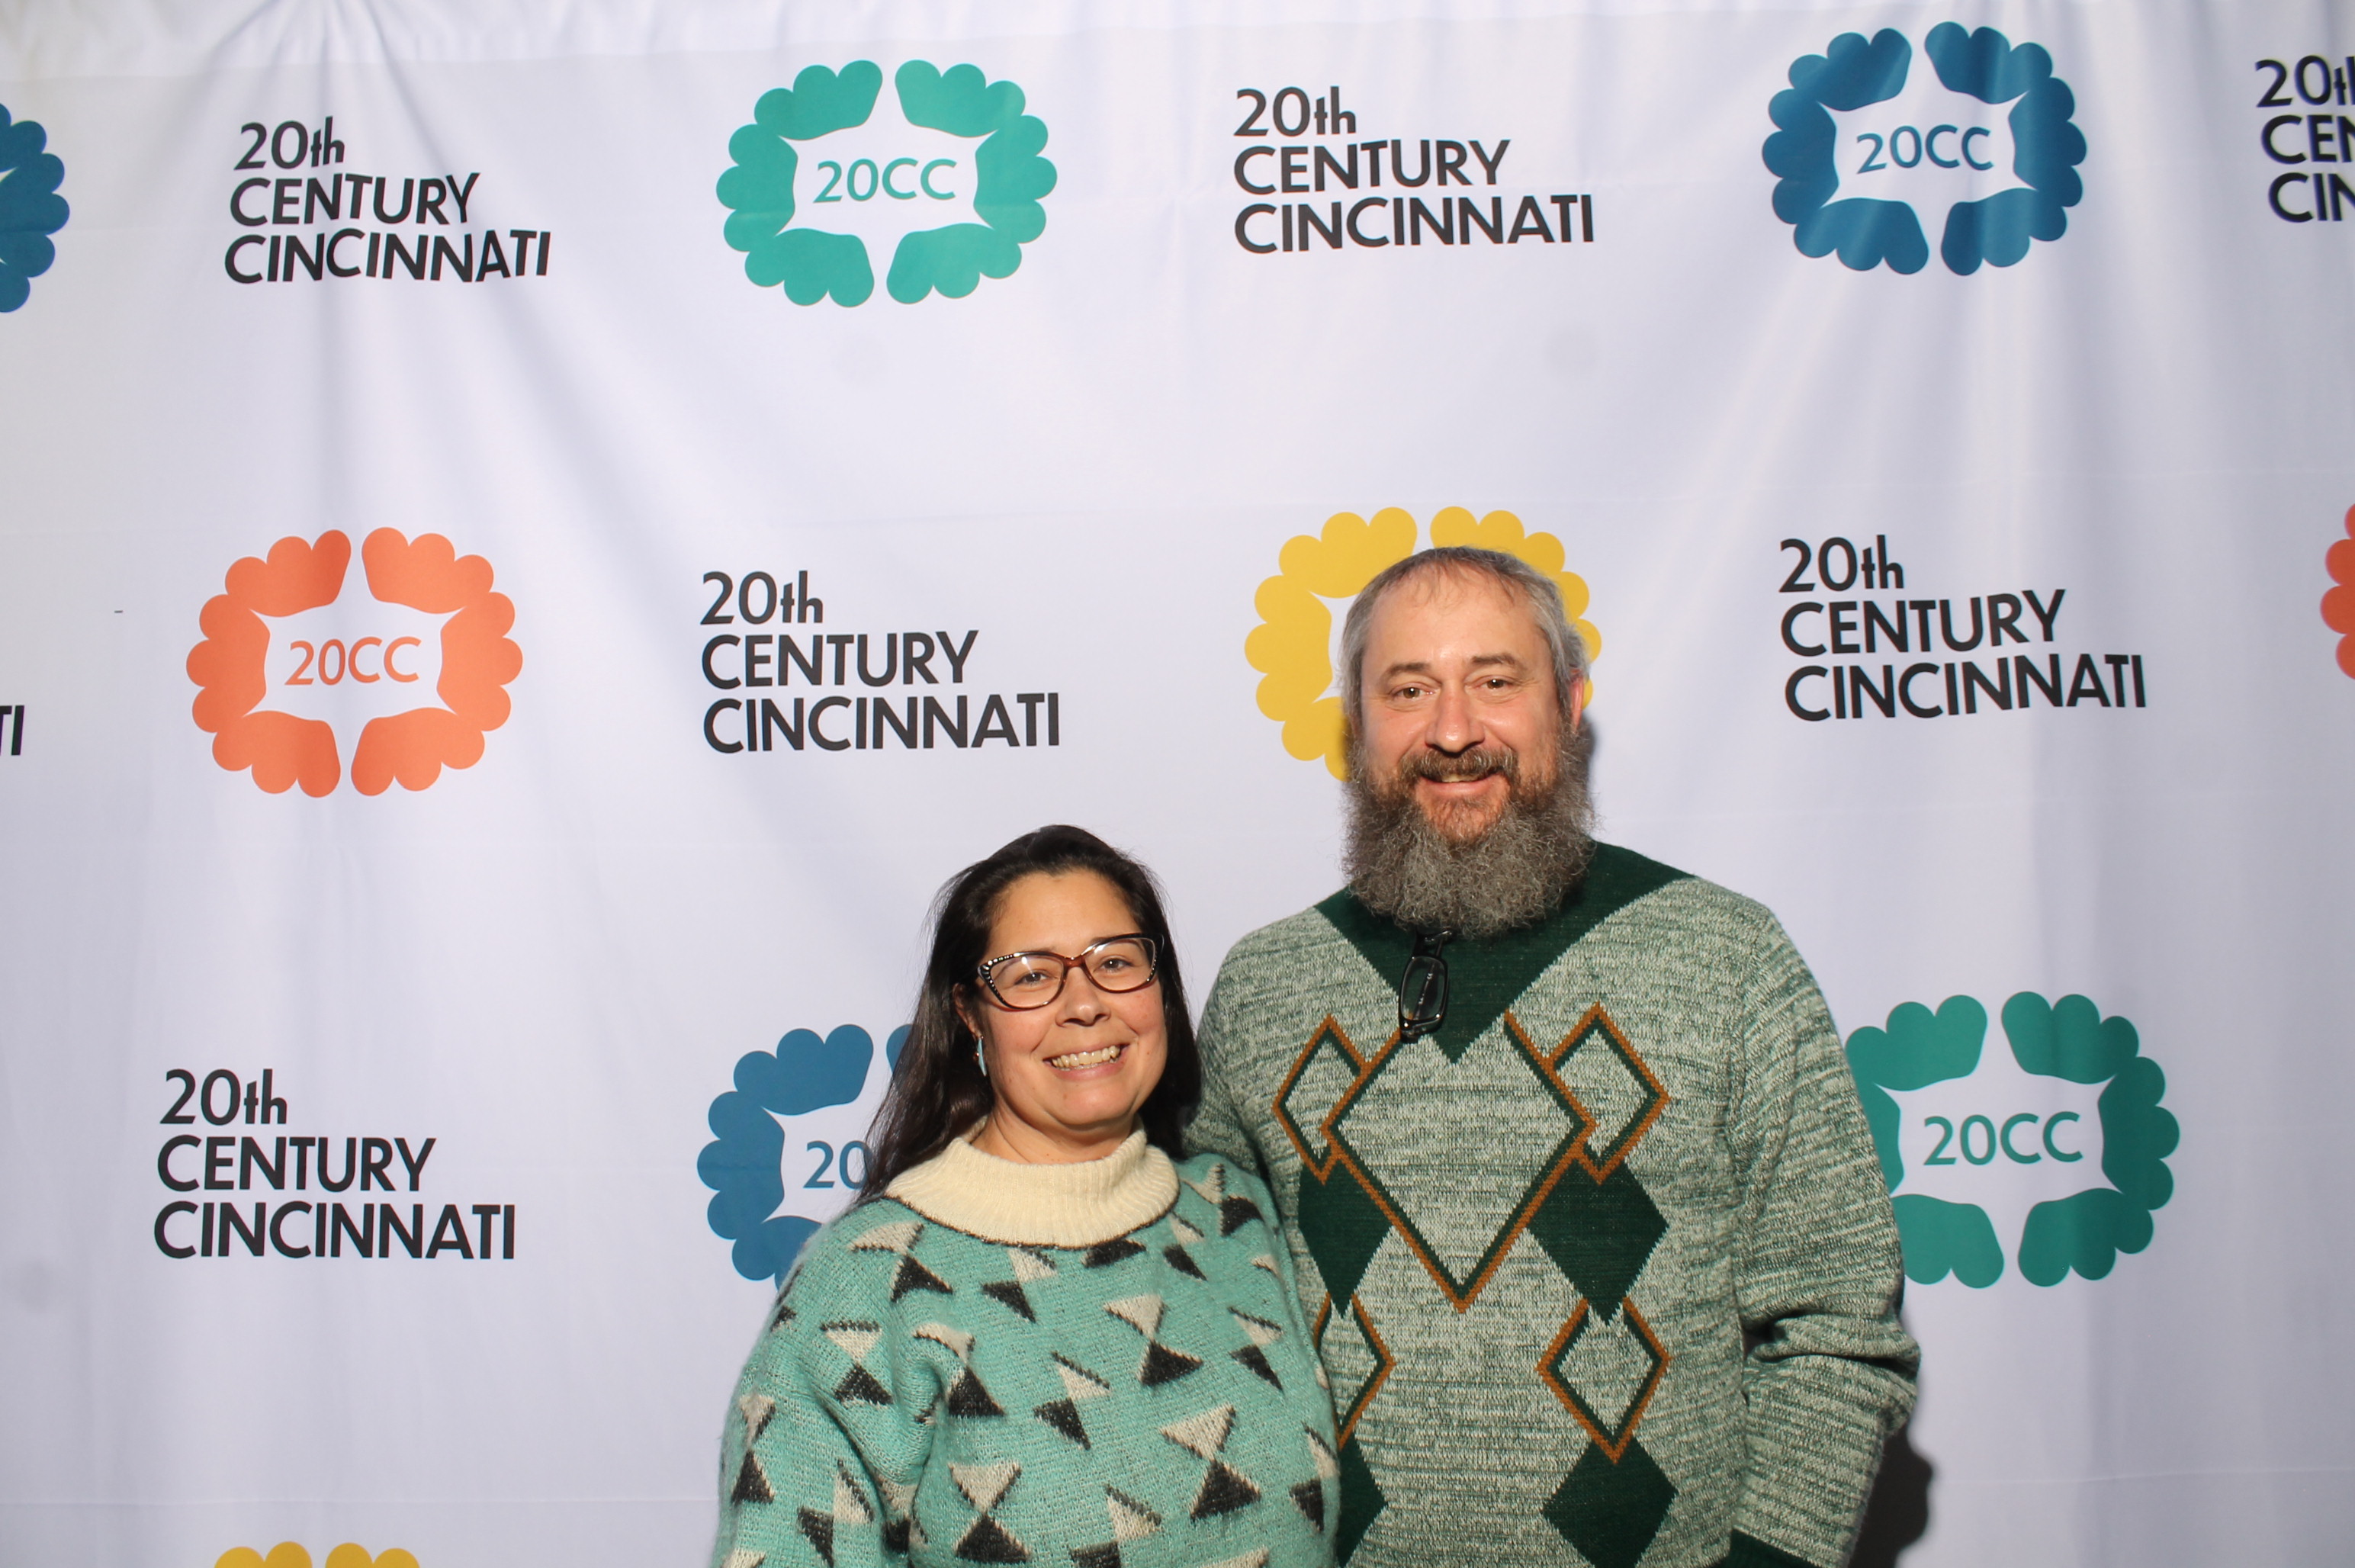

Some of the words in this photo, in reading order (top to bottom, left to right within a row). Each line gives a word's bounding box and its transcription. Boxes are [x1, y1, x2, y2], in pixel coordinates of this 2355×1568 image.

[1235, 86, 1356, 137] 20th
[233, 116, 345, 170] 20th
[1234, 140, 1510, 194] CENTURY
[1857, 123, 1994, 174] 20CC
[230, 172, 480, 227] CENTURY
[813, 156, 956, 203] 20CC
[1235, 194, 1594, 254] CINCINNATI
[224, 228, 551, 284] CINCINNATI
[1779, 535, 1904, 593] 20th
[700, 570, 823, 625] 20th
[1781, 589, 2065, 657] CENTURY
[285, 635, 422, 686] 20CC
[702, 630, 978, 689] CENTURY
[1785, 654, 2146, 721] CINCINNATI
[703, 692, 1059, 753] CINCINNATI
[159, 1068, 288, 1126] 20th
[157, 1134, 436, 1193] CENTURY
[1924, 1110, 2084, 1167] 20CC
[154, 1200, 515, 1259] CINCINNATI
